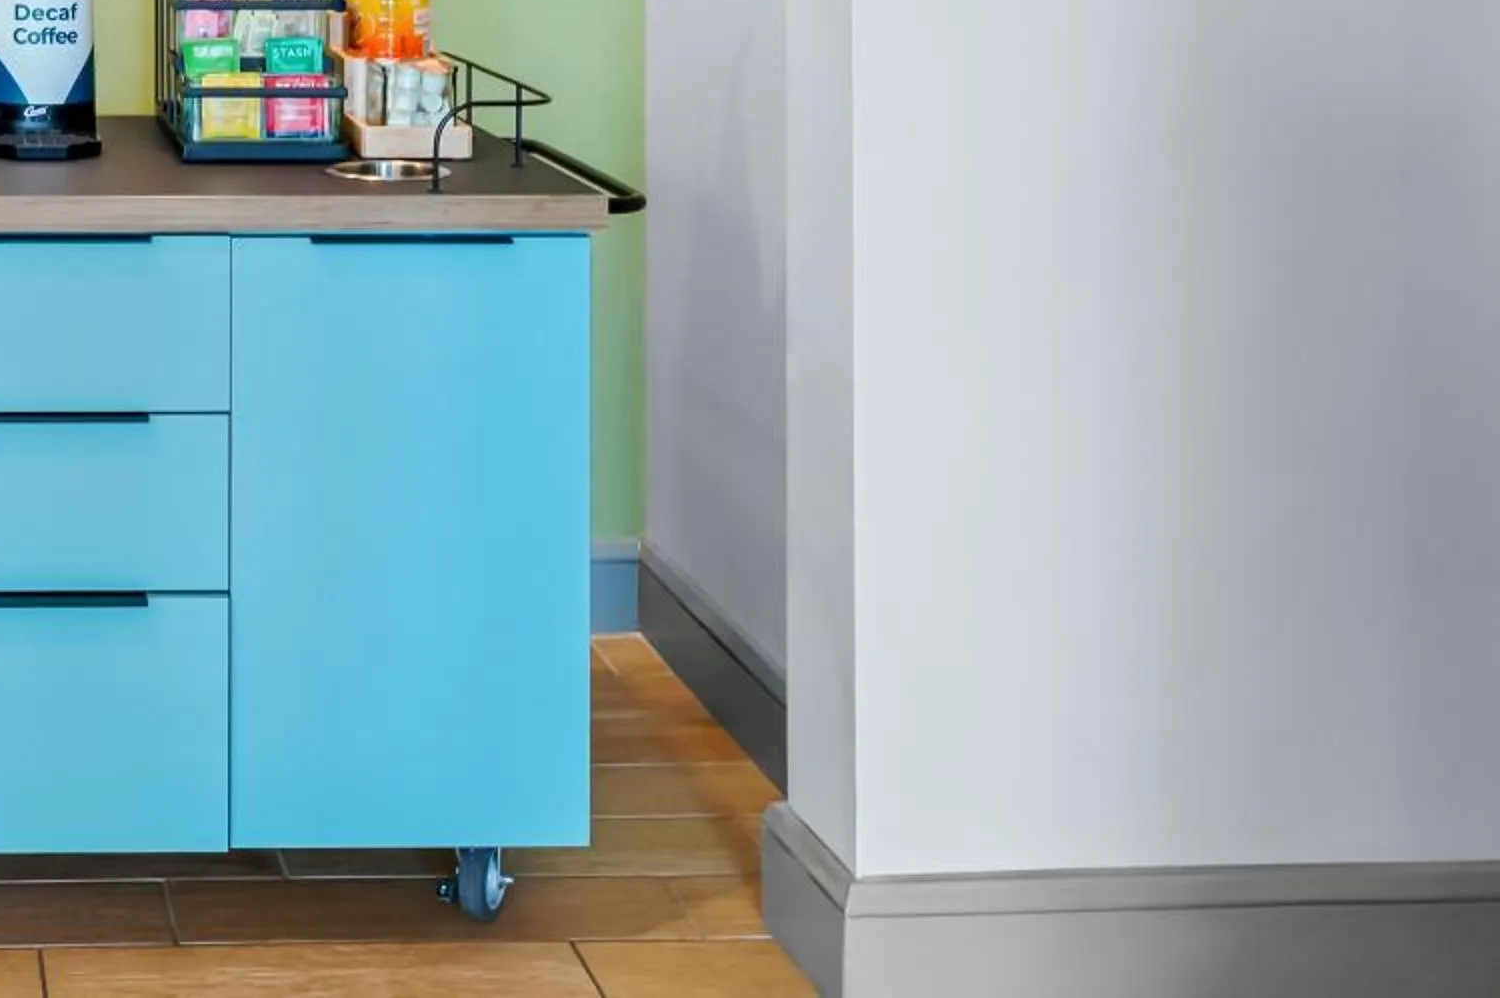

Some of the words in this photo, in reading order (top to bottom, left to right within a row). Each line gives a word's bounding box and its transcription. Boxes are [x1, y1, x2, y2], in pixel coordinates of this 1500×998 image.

[14, 2, 79, 21] Decaf
[13, 26, 79, 45] Coffee
[272, 47, 312, 59] STASH
